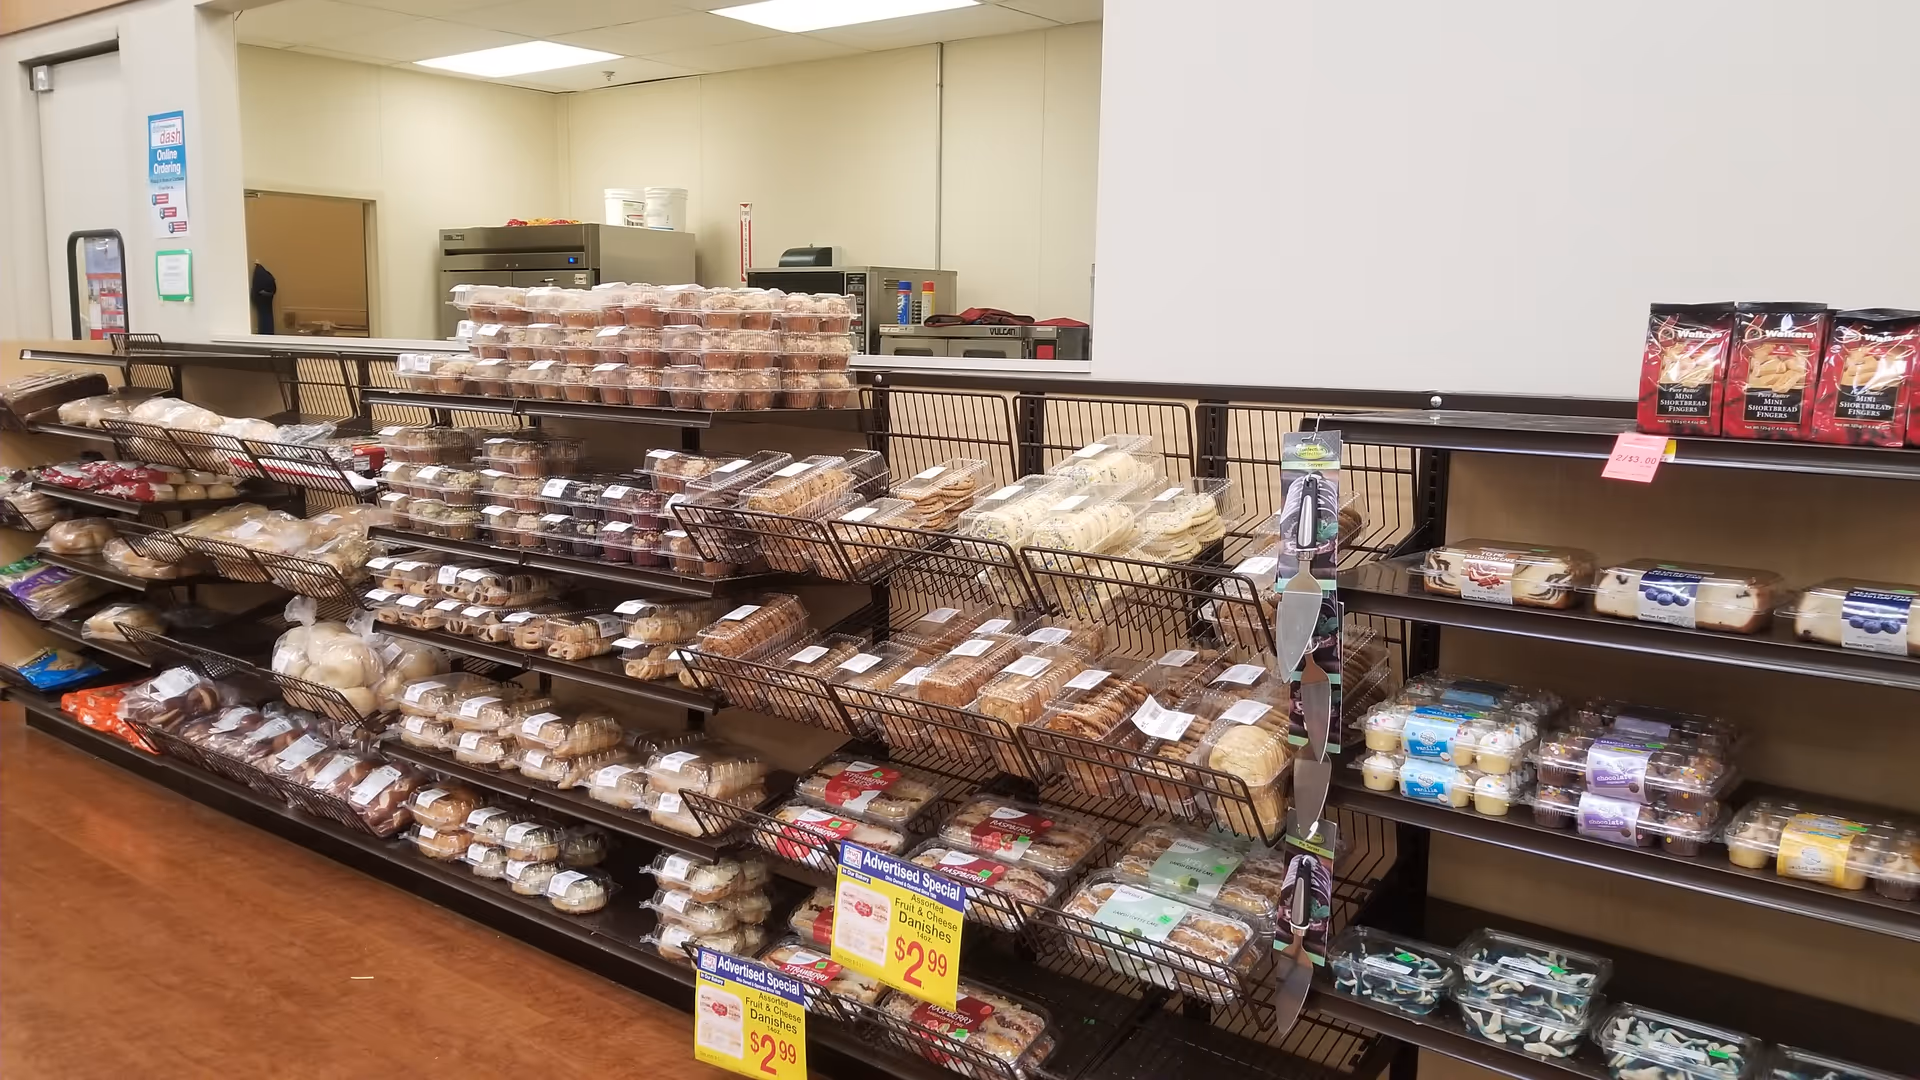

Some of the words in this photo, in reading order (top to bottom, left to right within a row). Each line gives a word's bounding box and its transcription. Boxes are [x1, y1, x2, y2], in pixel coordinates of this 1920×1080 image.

[160, 128, 182, 144] dash
[156, 149, 178, 161] Online
[154, 162, 181, 174] Ordering
[989, 327, 1016, 336] VULCAN
[1677, 330, 1722, 338] Walkers
[1765, 329, 1814, 338] Walkers
[1748, 404, 1798, 412] SHORTBREAD
[1839, 402, 1892, 410] SHORTBREAD
[1616, 454, 1656, 464] 2/$3.00
[844, 772, 888, 786] STRAWBERRY
[796, 821, 840, 838] STRAWBERRY
[990, 820, 1035, 835] RASPBERRY
[863, 851, 920, 884] Advertised
[922, 872, 960, 901] Special
[940, 866, 988, 883] RASPBERRY
[911, 894, 944, 914] Assorted
[894, 898, 915, 913] Fruit
[916, 907, 923, 917] &
[926, 910, 958, 932] Cheese
[899, 911, 952, 944] Danishes
[917, 931, 932, 944] 14oz.
[718, 956, 764, 983] Advertised
[767, 972, 800, 996] Special
[785, 964, 829, 981] STRAWBERRY
[759, 992, 788, 1008] Assorted
[746, 997, 763, 1010] Fruit
[774, 1006, 802, 1023] Cheese
[928, 1004, 974, 1025] RASPBERRY
[750, 1009, 797, 1034] Danishes
[767, 1026, 781, 1035] 14oz.
